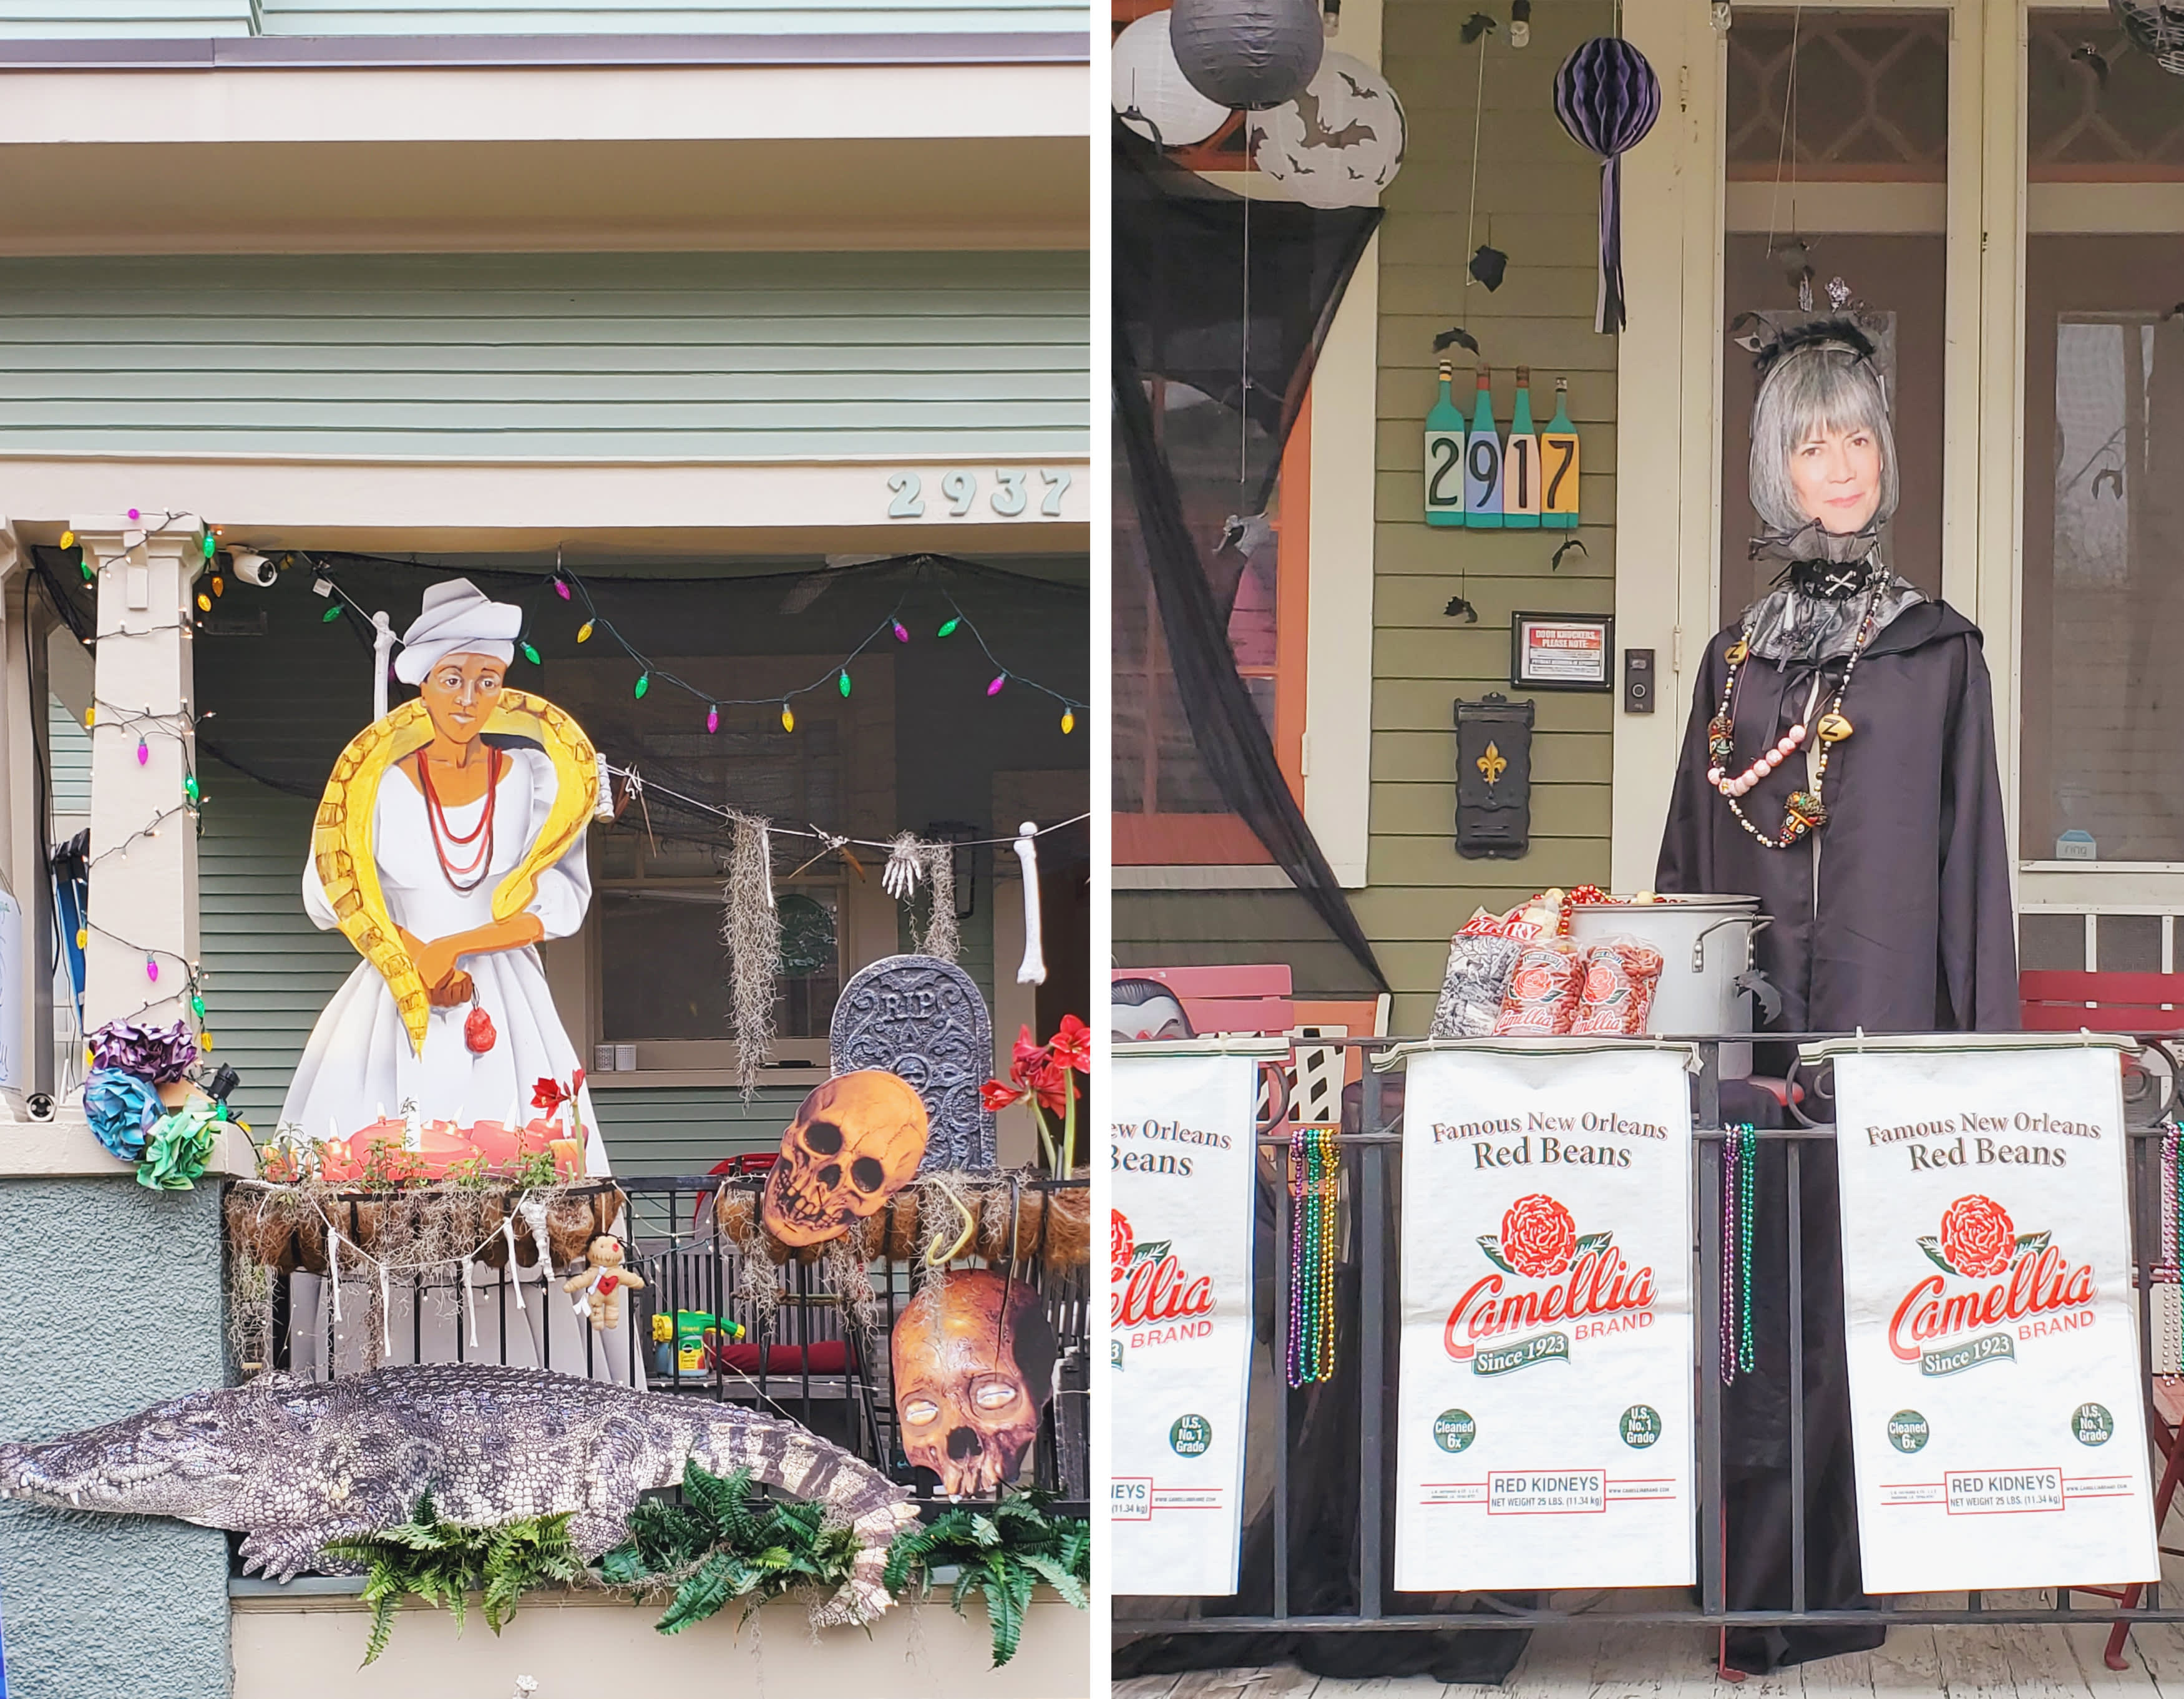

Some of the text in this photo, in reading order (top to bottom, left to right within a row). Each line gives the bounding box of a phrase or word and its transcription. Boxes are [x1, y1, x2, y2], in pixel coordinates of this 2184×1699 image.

[1429, 438, 1574, 509] 2917
[887, 468, 1072, 519] 2937
[1542, 639, 1567, 648] PLEASE
[1143, 1119, 1232, 1150] Orleans
[1431, 1112, 1668, 1143] Famous New Orleans
[1865, 1112, 2102, 1147] Famous New Orleans
[1471, 1136, 1632, 1170] Red Beans
[1907, 1137, 2067, 1172] Red Beans
[1443, 1246, 1658, 1361] Camellia
[1888, 1245, 2097, 1362] Camellia
[1575, 1311, 1655, 1341] BRAND
[2019, 1310, 2095, 1341] BRAND
[1131, 1320, 1214, 1348] BRAND
[1478, 1336, 1565, 1373] Since 1923
[1924, 1336, 2011, 1373] Since 1923
[1631, 1407, 1650, 1419] U.S.
[2082, 1405, 2101, 1418] U.S.
[1181, 1417, 1202, 1429] U.S.
[1435, 1420, 1474, 1434] Cleaned
[1628, 1418, 1652, 1431] No. 1
[1889, 1421, 1927, 1434] Cleaned
[2080, 1417, 2104, 1429] No. 1
[1178, 1428, 1203, 1441] No. 1
[1447, 1433, 1462, 1449] 6x
[1626, 1431, 1655, 1444] Grade
[1901, 1434, 1916, 1449] 6x
[2079, 1429, 2108, 1441] Grade
[1176, 1441, 1205, 1452] Grade
[1495, 1476, 1599, 1493] RED KIDNEYS
[1952, 1474, 2055, 1493] RED KIDNEYS
[1111, 1484, 1146, 1499] EYS
[1491, 1496, 1602, 1507] NET WEIGHT 25 LBS. (11.34 kg)
[1951, 1494, 2061, 1507] NET WEIGHT 25 LBS. (11.34 kg)
[1136, 1503, 1148, 1515] kg)
